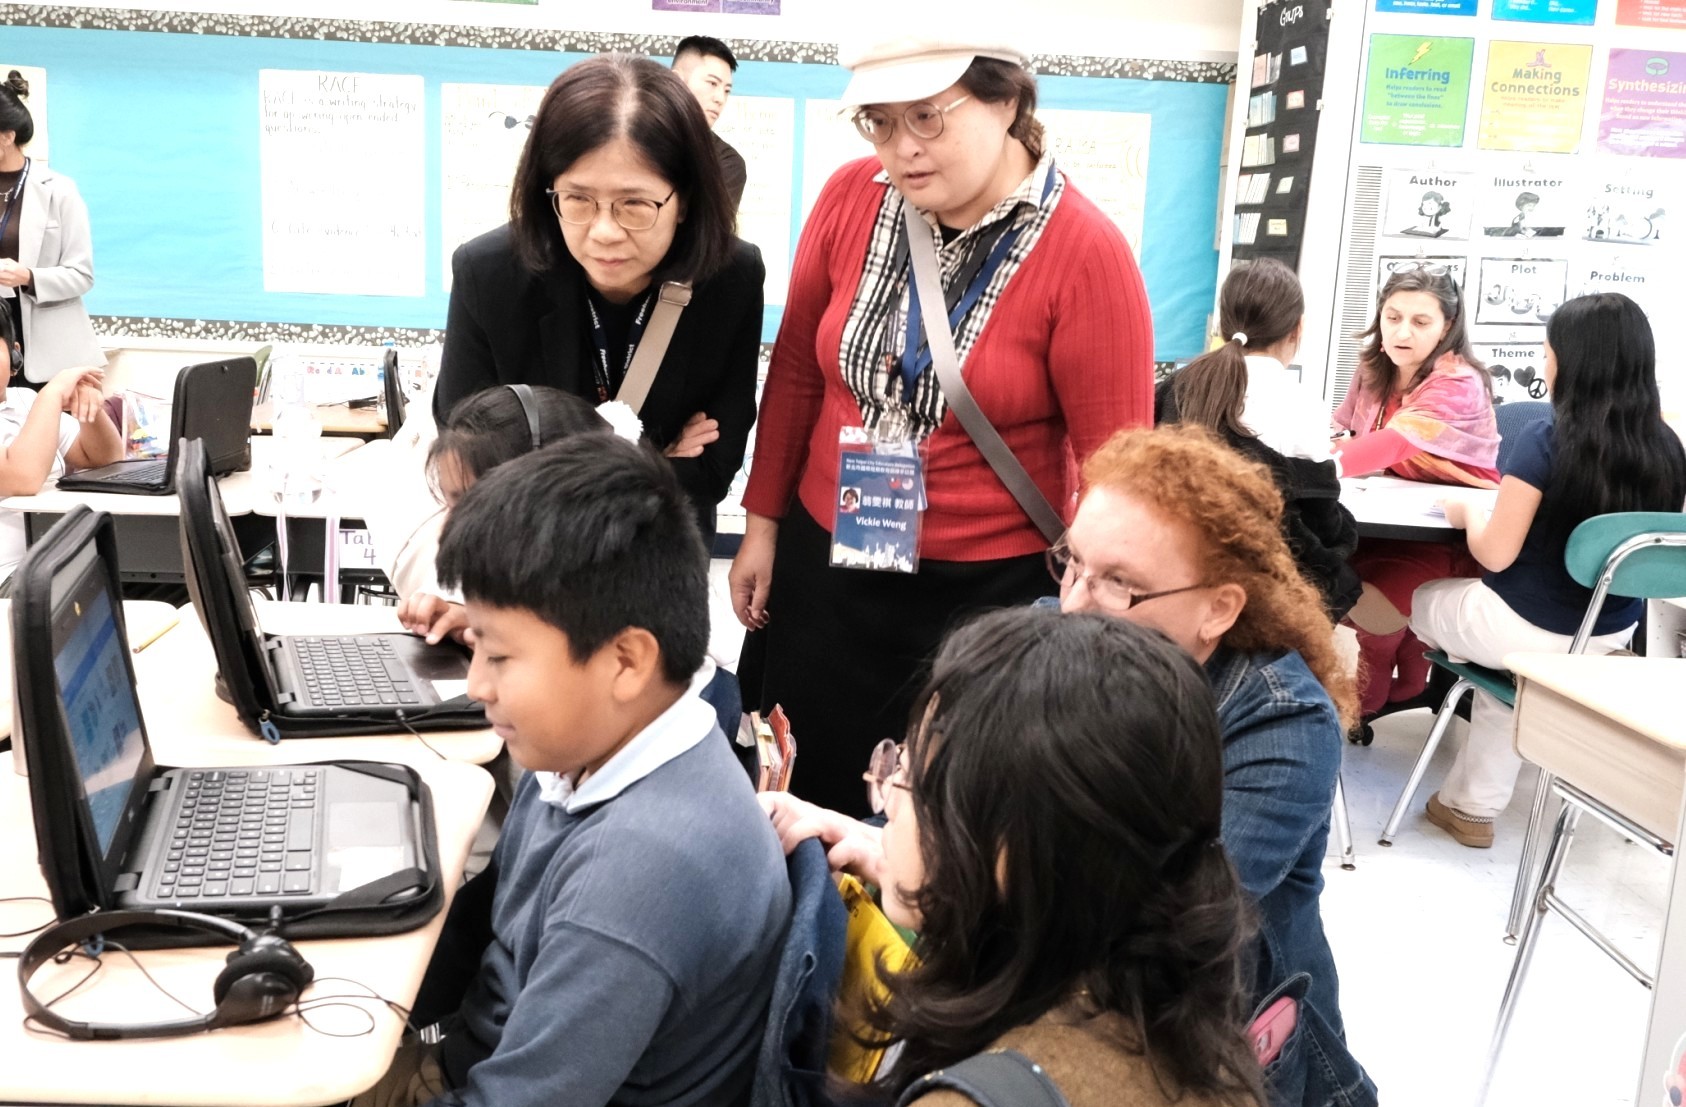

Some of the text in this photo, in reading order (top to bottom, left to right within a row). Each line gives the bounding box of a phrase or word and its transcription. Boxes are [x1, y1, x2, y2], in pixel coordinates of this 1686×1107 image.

[1386, 67, 1450, 84] Inferring
[1512, 68, 1562, 84] Making
[1491, 82, 1580, 96] Connections
[1410, 176, 1457, 187] Author
[1494, 176, 1563, 188] Illustrator
[1604, 184, 1654, 198] Setting
[1512, 264, 1537, 274] Plot
[1590, 270, 1645, 284] Problem
[1492, 348, 1535, 358] Theme
[856, 516, 906, 532] Vickie Weng
[364, 548, 376, 566] 4
